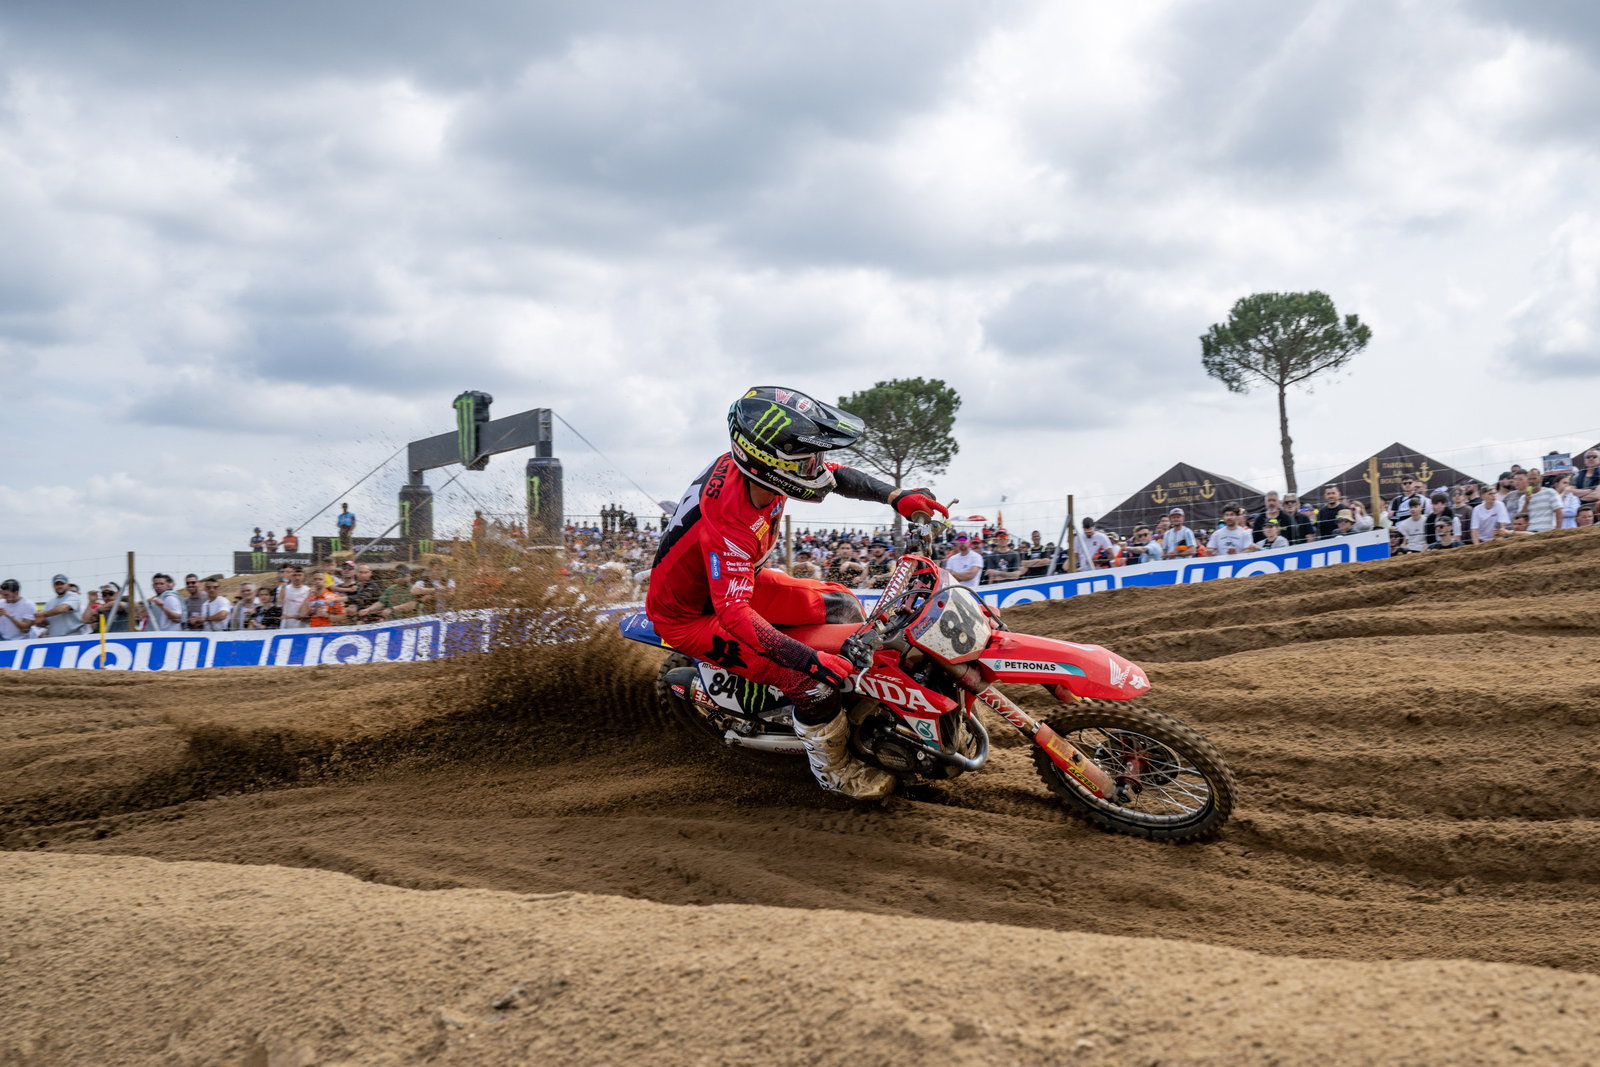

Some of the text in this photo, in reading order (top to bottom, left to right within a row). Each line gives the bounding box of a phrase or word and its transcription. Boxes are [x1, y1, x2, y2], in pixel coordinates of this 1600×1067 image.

[741, 440, 791, 468] OAKLEY
[765, 472, 803, 493] MONSTER
[1004, 661, 1057, 672] PETRONAS
[709, 672, 739, 699] 84
